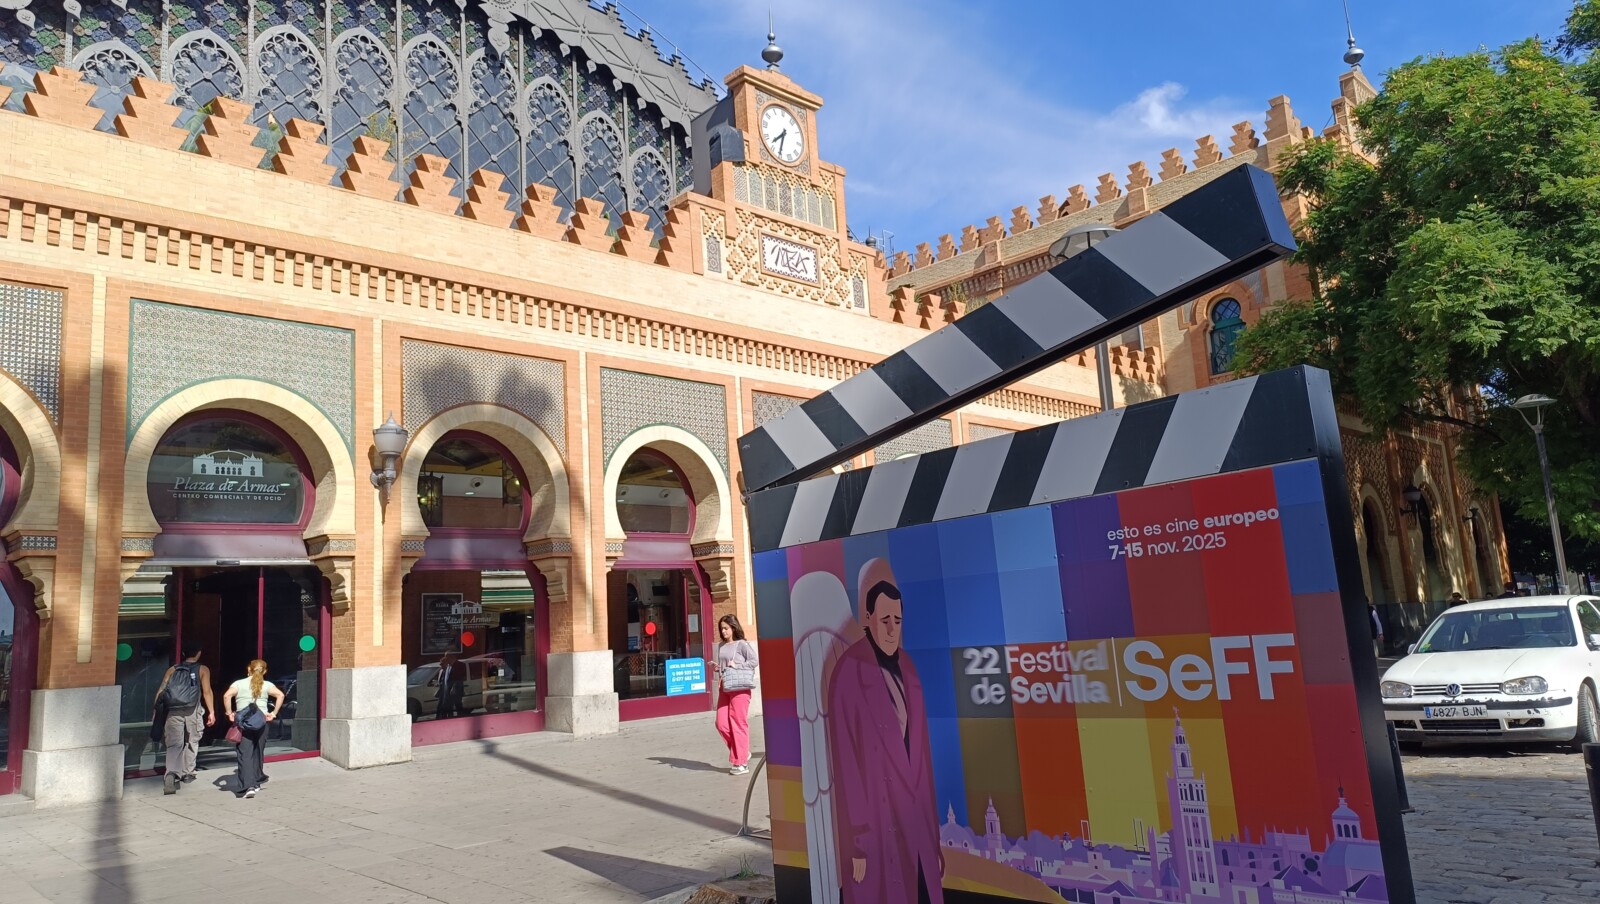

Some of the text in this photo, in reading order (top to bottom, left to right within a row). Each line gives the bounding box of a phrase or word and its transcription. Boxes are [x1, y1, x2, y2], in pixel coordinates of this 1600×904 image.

[174, 476, 281, 493] Plaza de Armas
[1107, 507, 1280, 541] esto es cine europeo
[1108, 531, 1227, 560] 7-15 nov. 2025
[963, 640, 1111, 675] 22 Festival
[1123, 633, 1296, 702] SeFF
[970, 674, 1112, 705] de Sevilla
[1432, 706, 1484, 717] 4827 BJN
